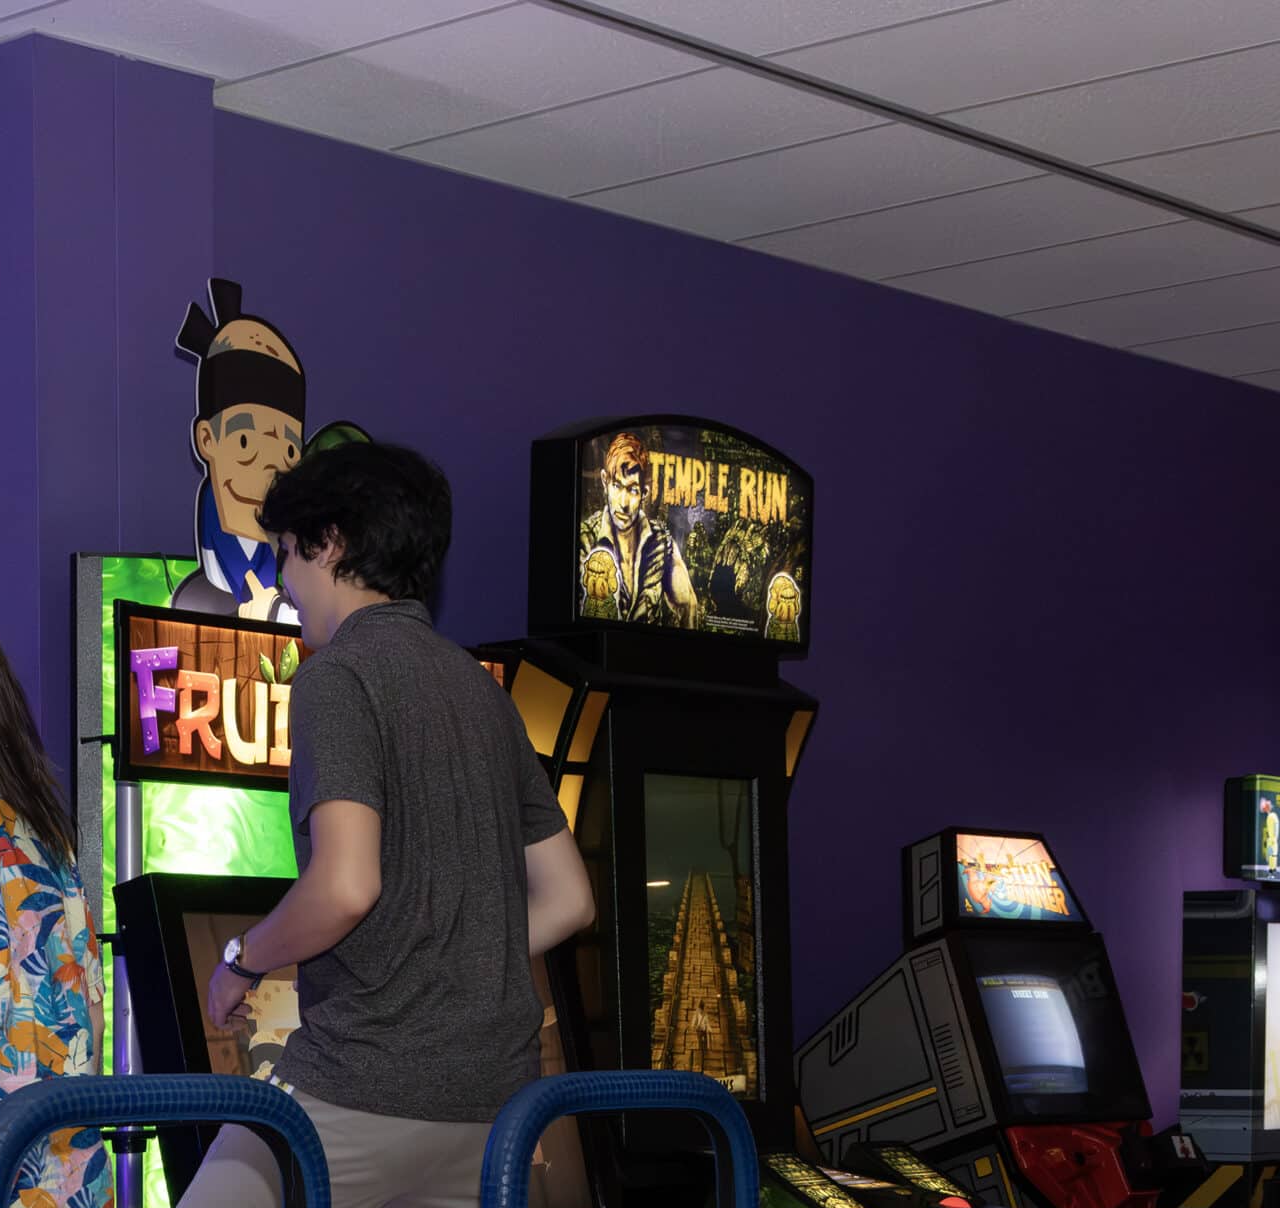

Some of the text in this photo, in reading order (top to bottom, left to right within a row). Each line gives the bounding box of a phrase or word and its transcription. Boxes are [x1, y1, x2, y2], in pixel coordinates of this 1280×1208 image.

[648, 450, 788, 525] TEMPLE RUN
[130, 646, 292, 767] FRUI
